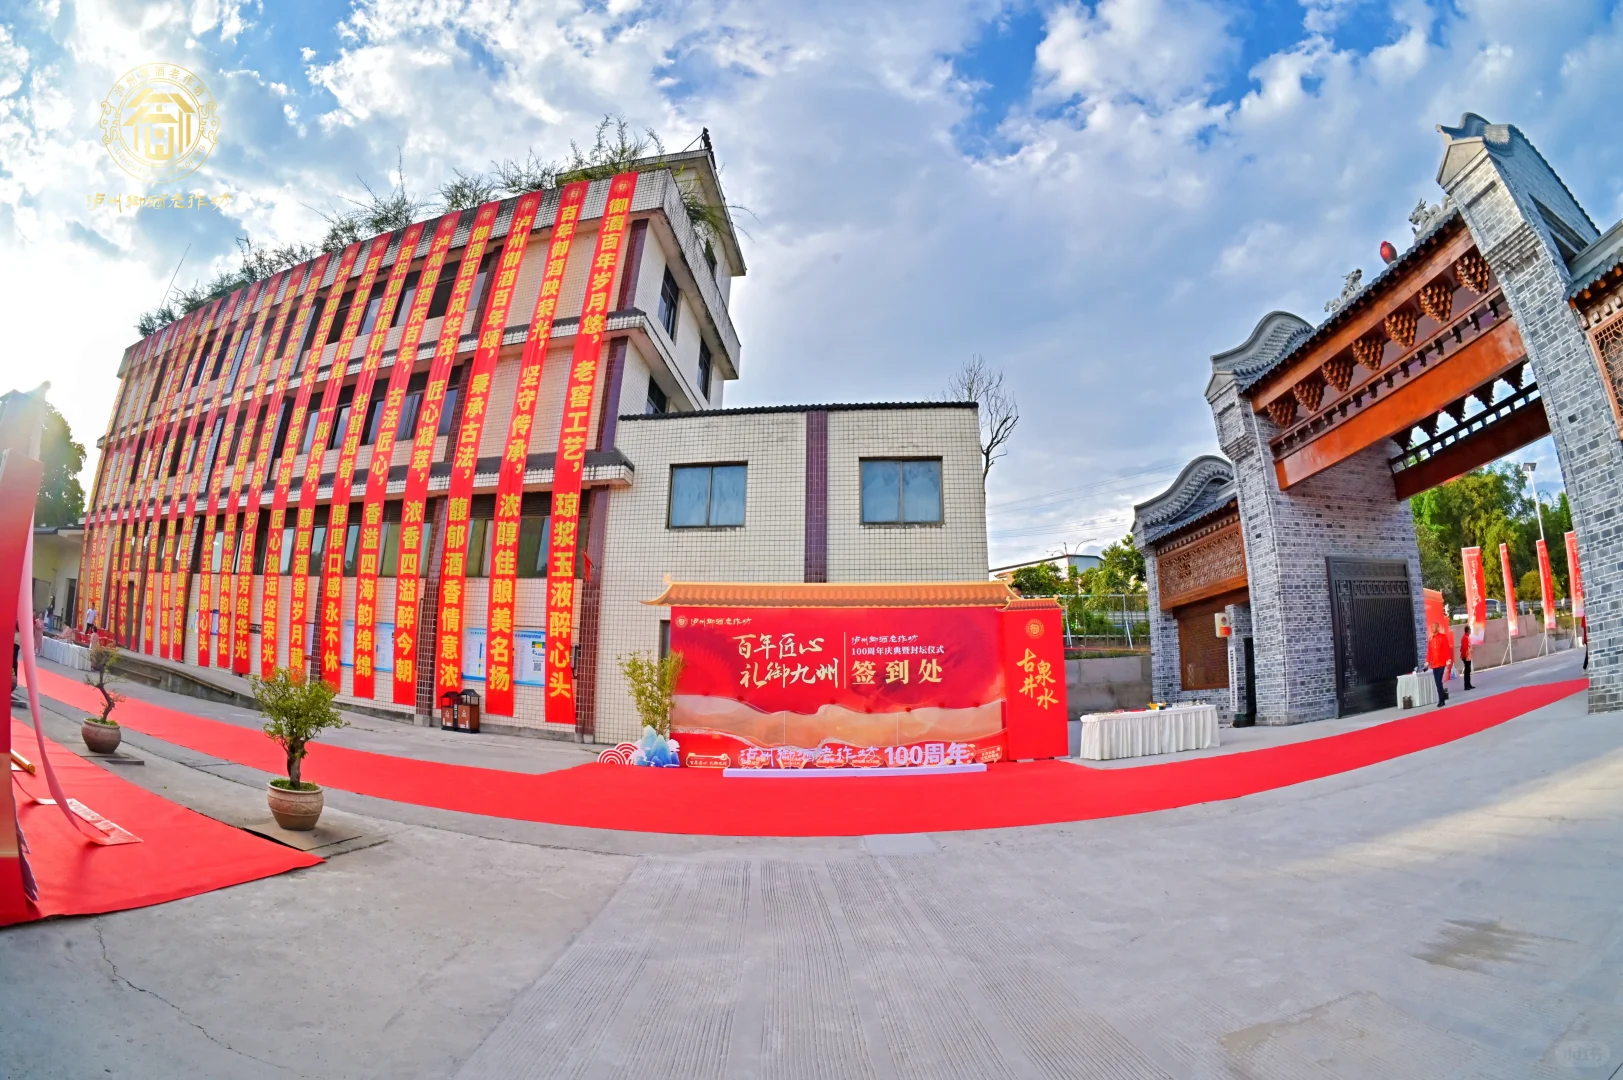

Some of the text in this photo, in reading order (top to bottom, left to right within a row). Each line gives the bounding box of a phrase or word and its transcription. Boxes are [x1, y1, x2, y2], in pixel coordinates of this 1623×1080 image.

[235, 512, 256, 659] 岁月流芳绽华光
[262, 510, 284, 664] 匠心独运绽荣光
[324, 504, 347, 672] 醇厚口感永不休
[355, 502, 381, 678] 香溢四海韵绵绵
[395, 500, 422, 683] 浓香四溢醉今朝
[439, 497, 469, 688] 馥郁酒香情意浓
[489, 492, 520, 692] 浓醇佳酿美名扬
[549, 491, 579, 699] 琼浆玉液醉心头
[732, 632, 824, 660] 百年匠心
[851, 645, 945, 656] 100周年庆典暨封坛仪式
[739, 657, 839, 689] 礼御九州
[851, 658, 943, 685] 签到处
[884, 742, 969, 766] 100周年
